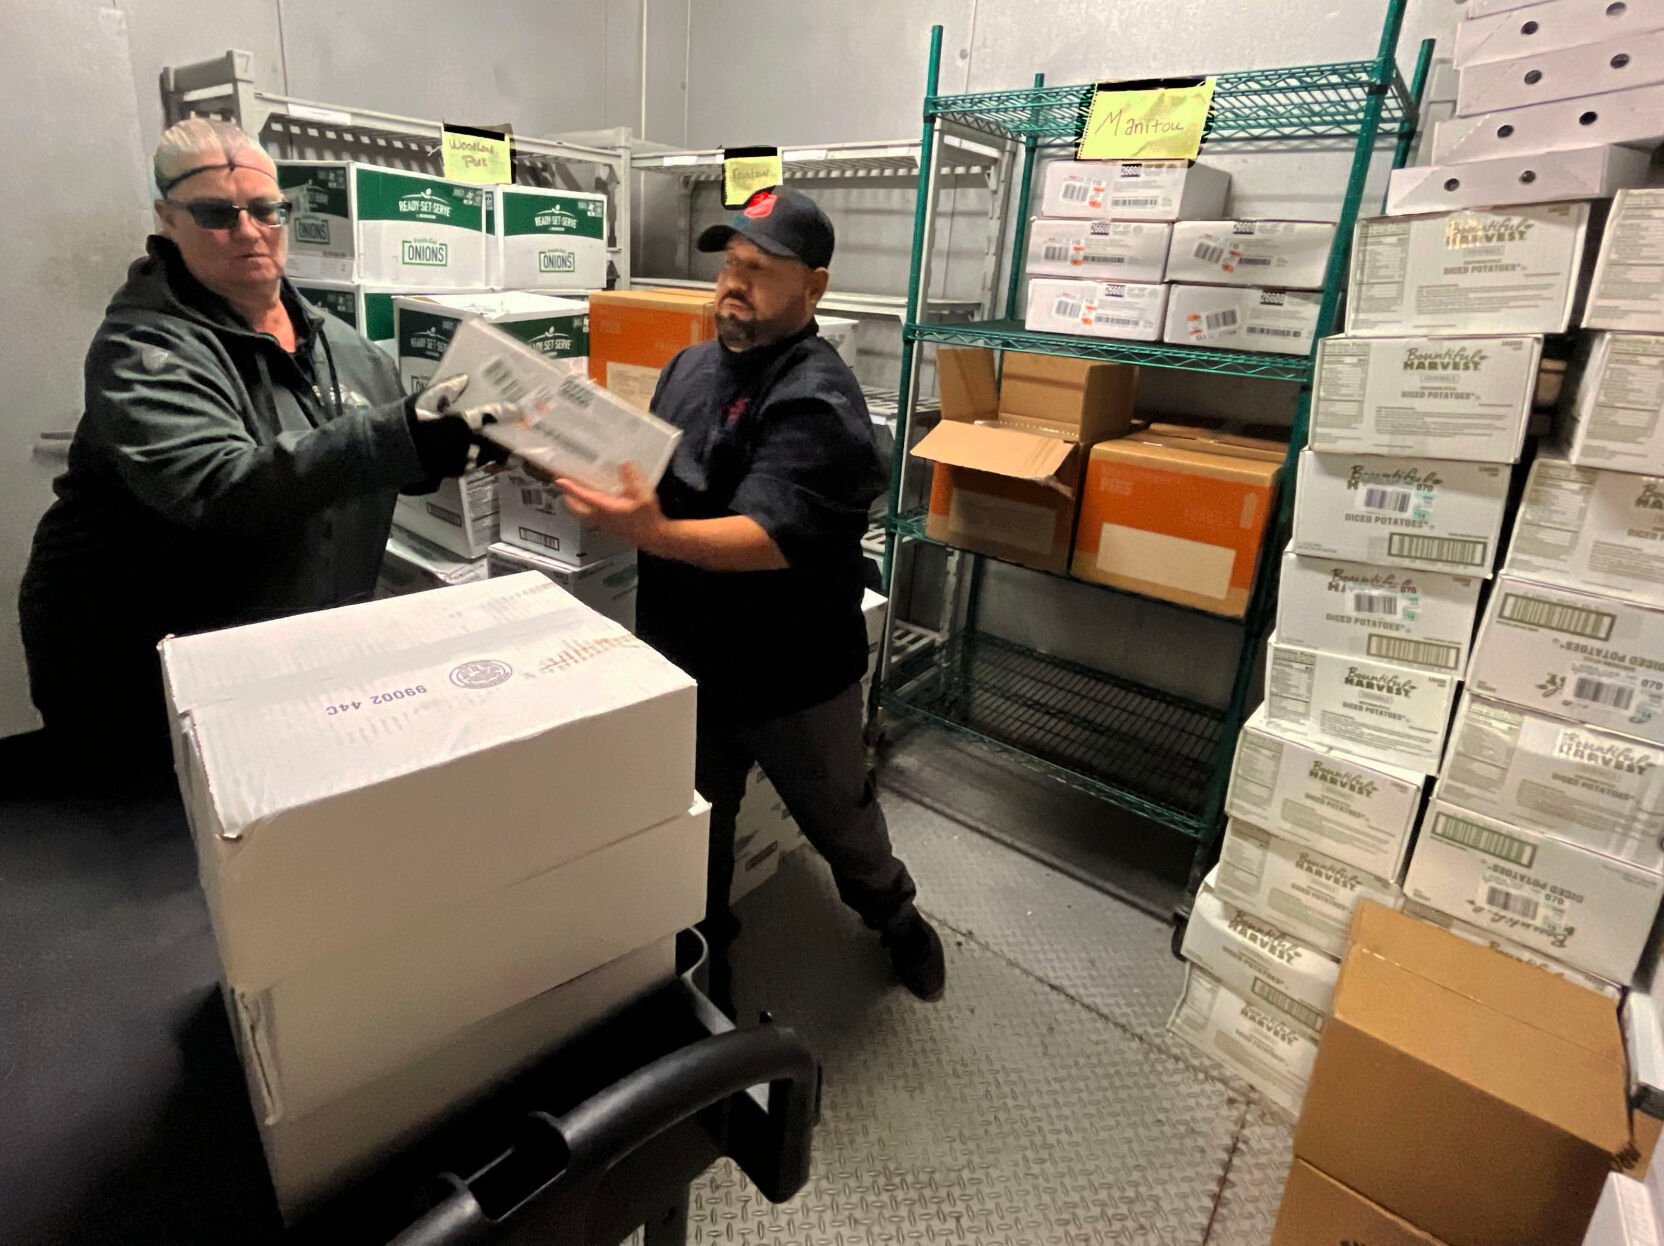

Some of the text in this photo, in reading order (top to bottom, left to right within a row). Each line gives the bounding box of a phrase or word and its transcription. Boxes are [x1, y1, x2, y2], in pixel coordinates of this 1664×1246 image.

[1095, 109, 1185, 137] Manitou
[449, 138, 494, 154] Woodland
[462, 154, 488, 168] Park
[407, 244, 444, 262] ONIONS
[543, 254, 572, 269] ONIONS
[1406, 347, 1484, 361] Bountiful
[1403, 361, 1481, 371] HARVEST
[1416, 484, 1434, 492] 070
[1345, 512, 1372, 524] DICED
[1400, 585, 1417, 594] 070
[1325, 612, 1352, 624] DICED
[1346, 666, 1412, 690] Bountiful
[1641, 679, 1663, 690] 070
[1344, 677, 1412, 697] HARVEST
[326, 685, 428, 716] 99002 44C
[1309, 769, 1373, 798] HARVEST
[1311, 760, 1373, 790] Bountiful
[1295, 860, 1357, 892] HARVEST
[1299, 852, 1359, 884] Bountiful
[1545, 893, 1564, 905] 070
[1550, 885, 1584, 903] DICED
[1228, 919, 1296, 966] HARVEST
